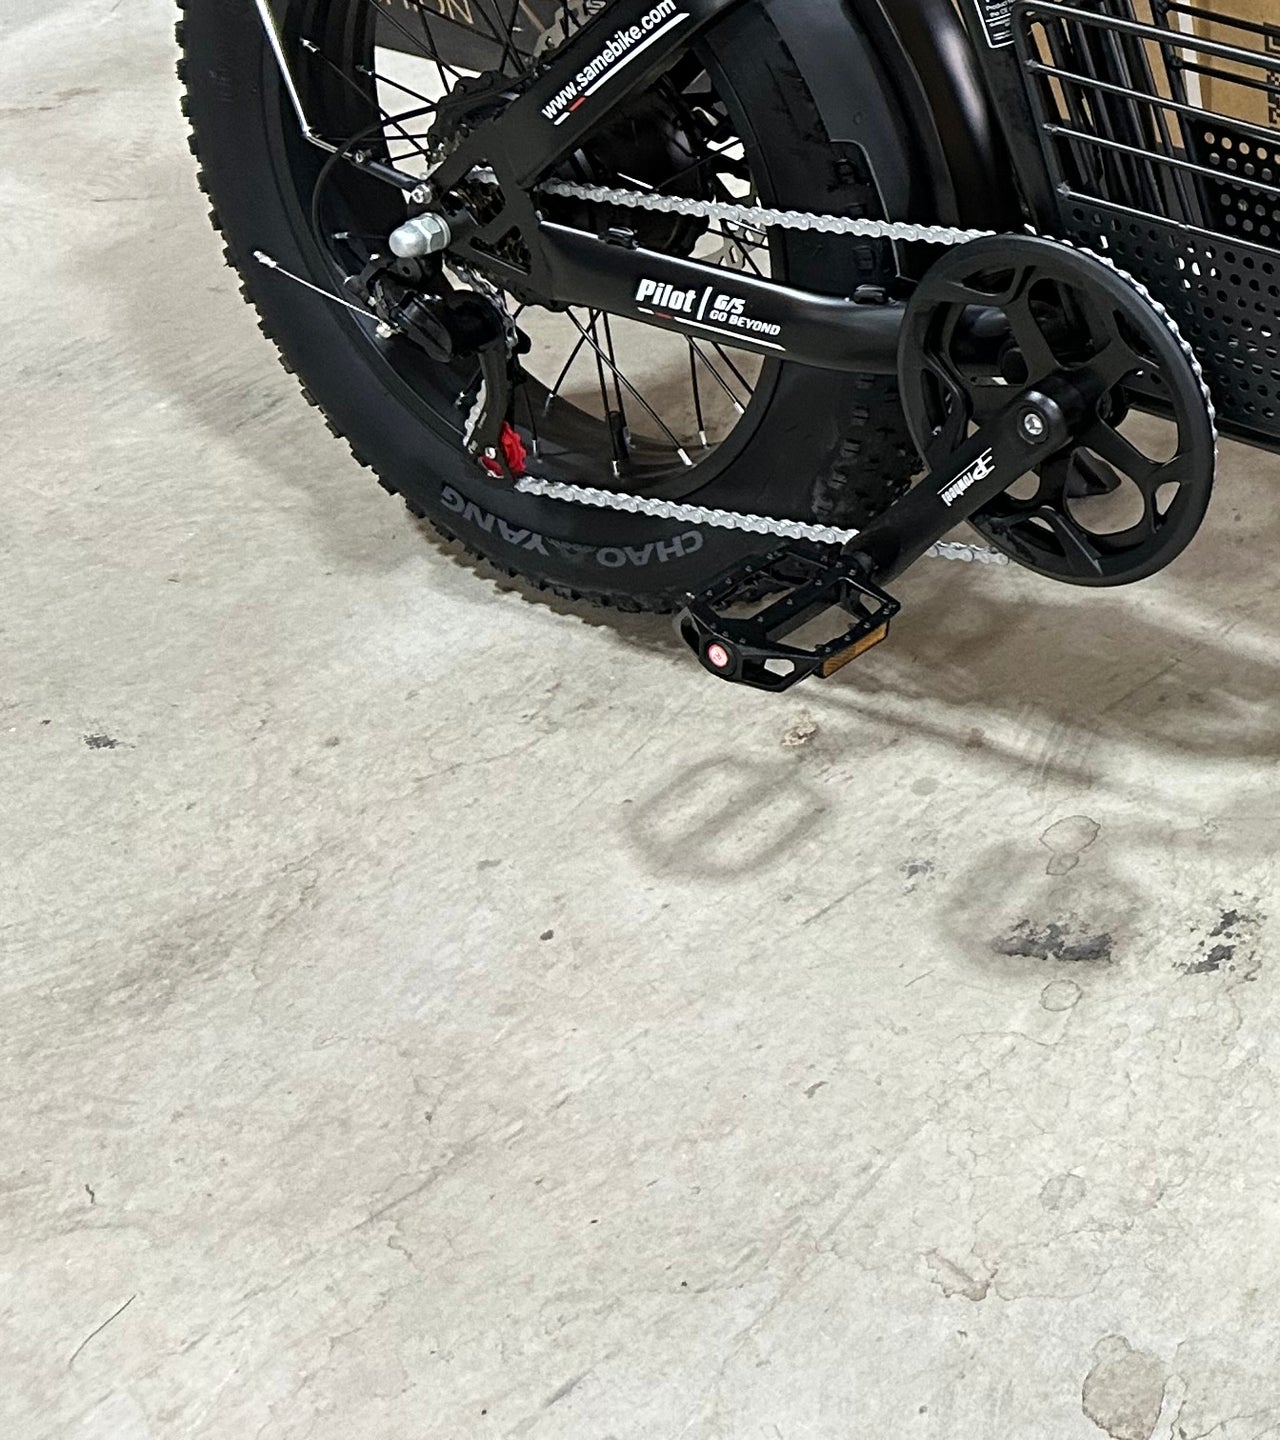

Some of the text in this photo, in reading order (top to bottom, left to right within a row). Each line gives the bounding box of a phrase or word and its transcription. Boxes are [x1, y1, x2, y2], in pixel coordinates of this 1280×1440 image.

[635, 278, 697, 313] Pilot
[709, 310, 781, 336] GO BEYOND
[440, 485, 705, 568] CHAO YANG
